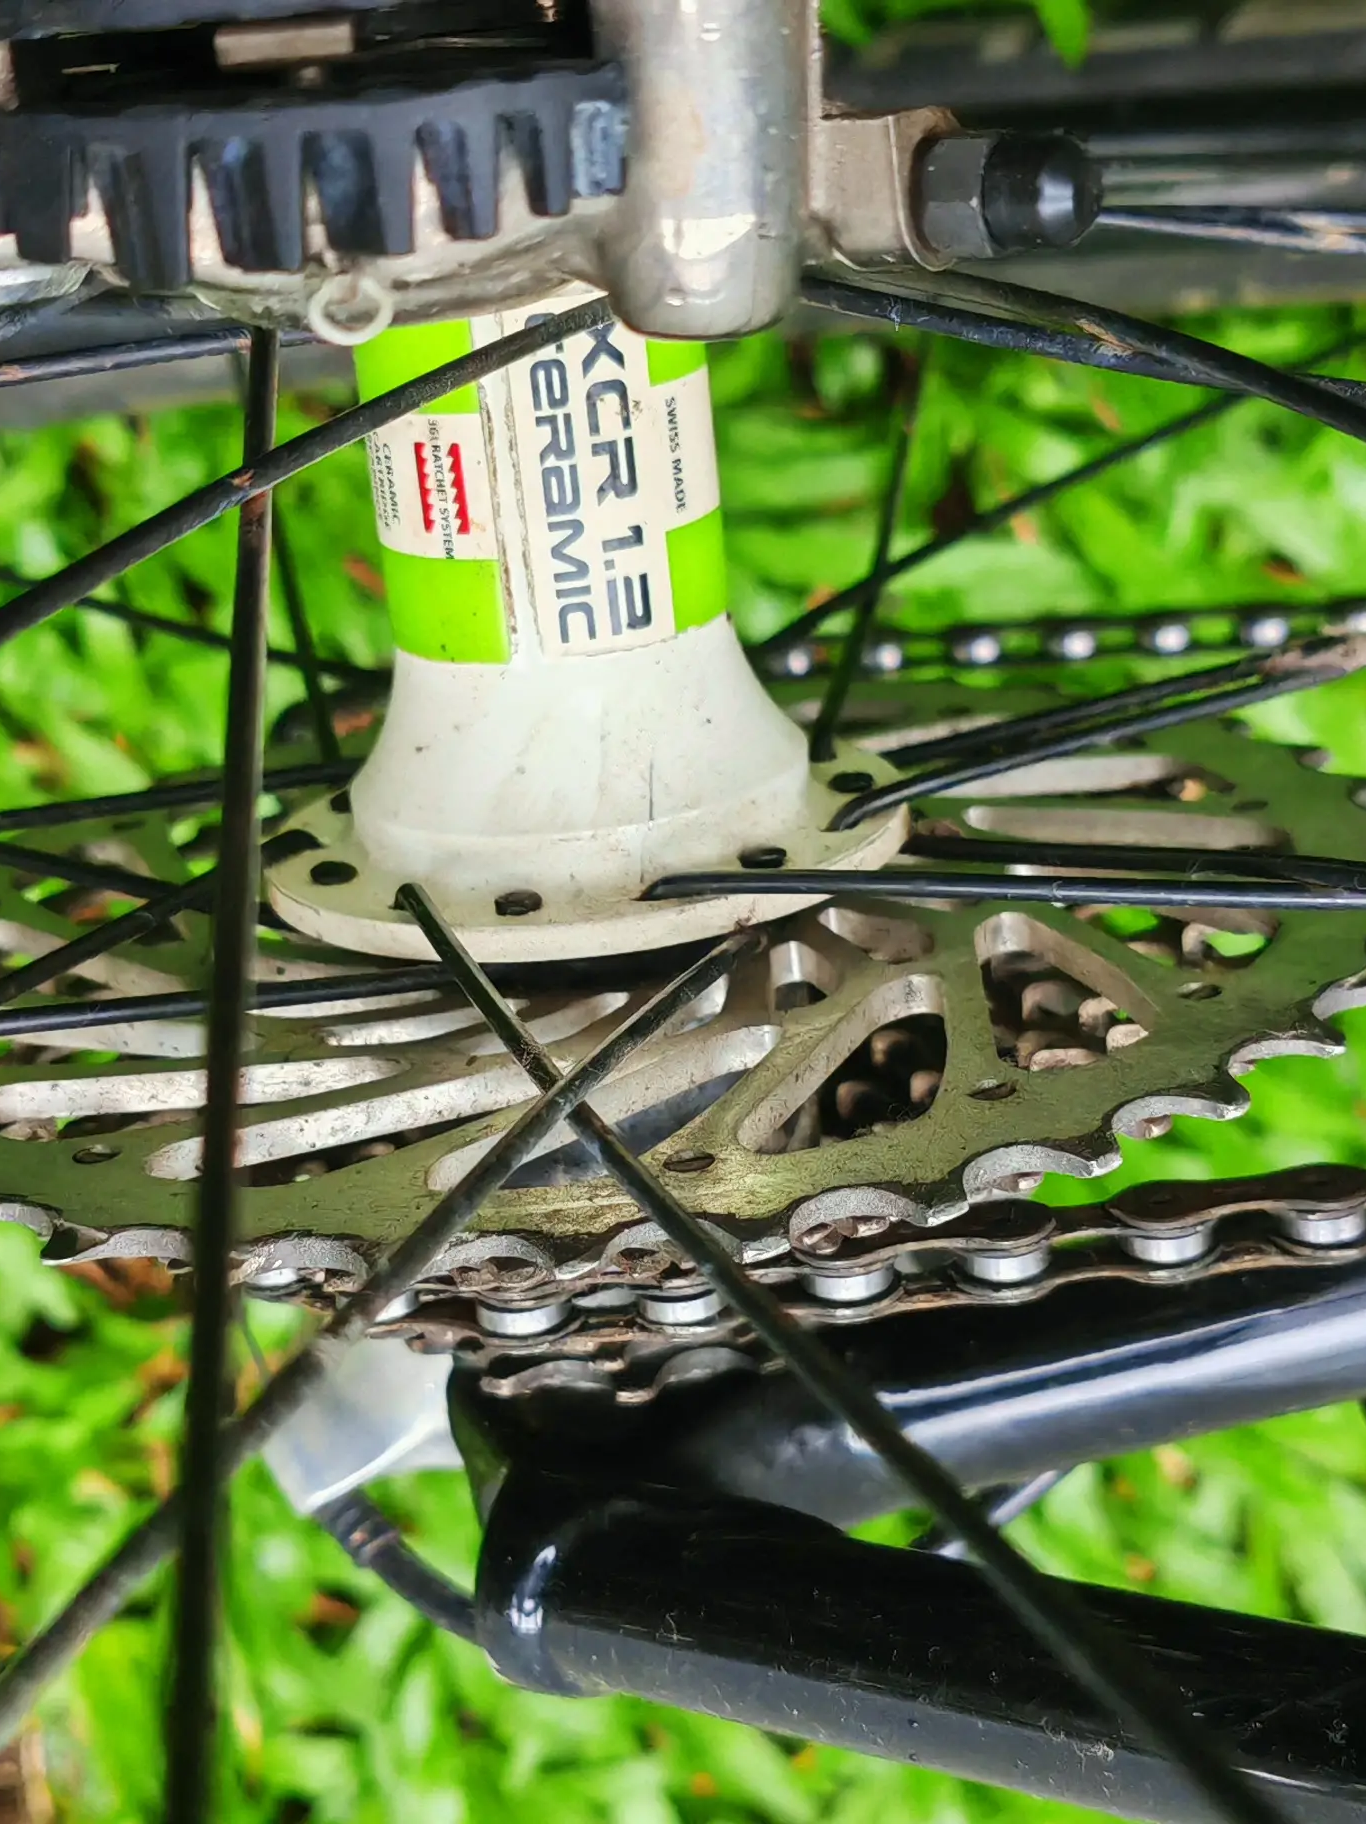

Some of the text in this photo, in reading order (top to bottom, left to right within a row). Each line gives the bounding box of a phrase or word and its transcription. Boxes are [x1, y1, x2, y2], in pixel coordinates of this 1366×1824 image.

[431, 444, 448, 503] RATCHET
[582, 320, 653, 636] XCR 1.2
[665, 396, 687, 513] SWISS MADE
[438, 507, 455, 559] SYSTEM
